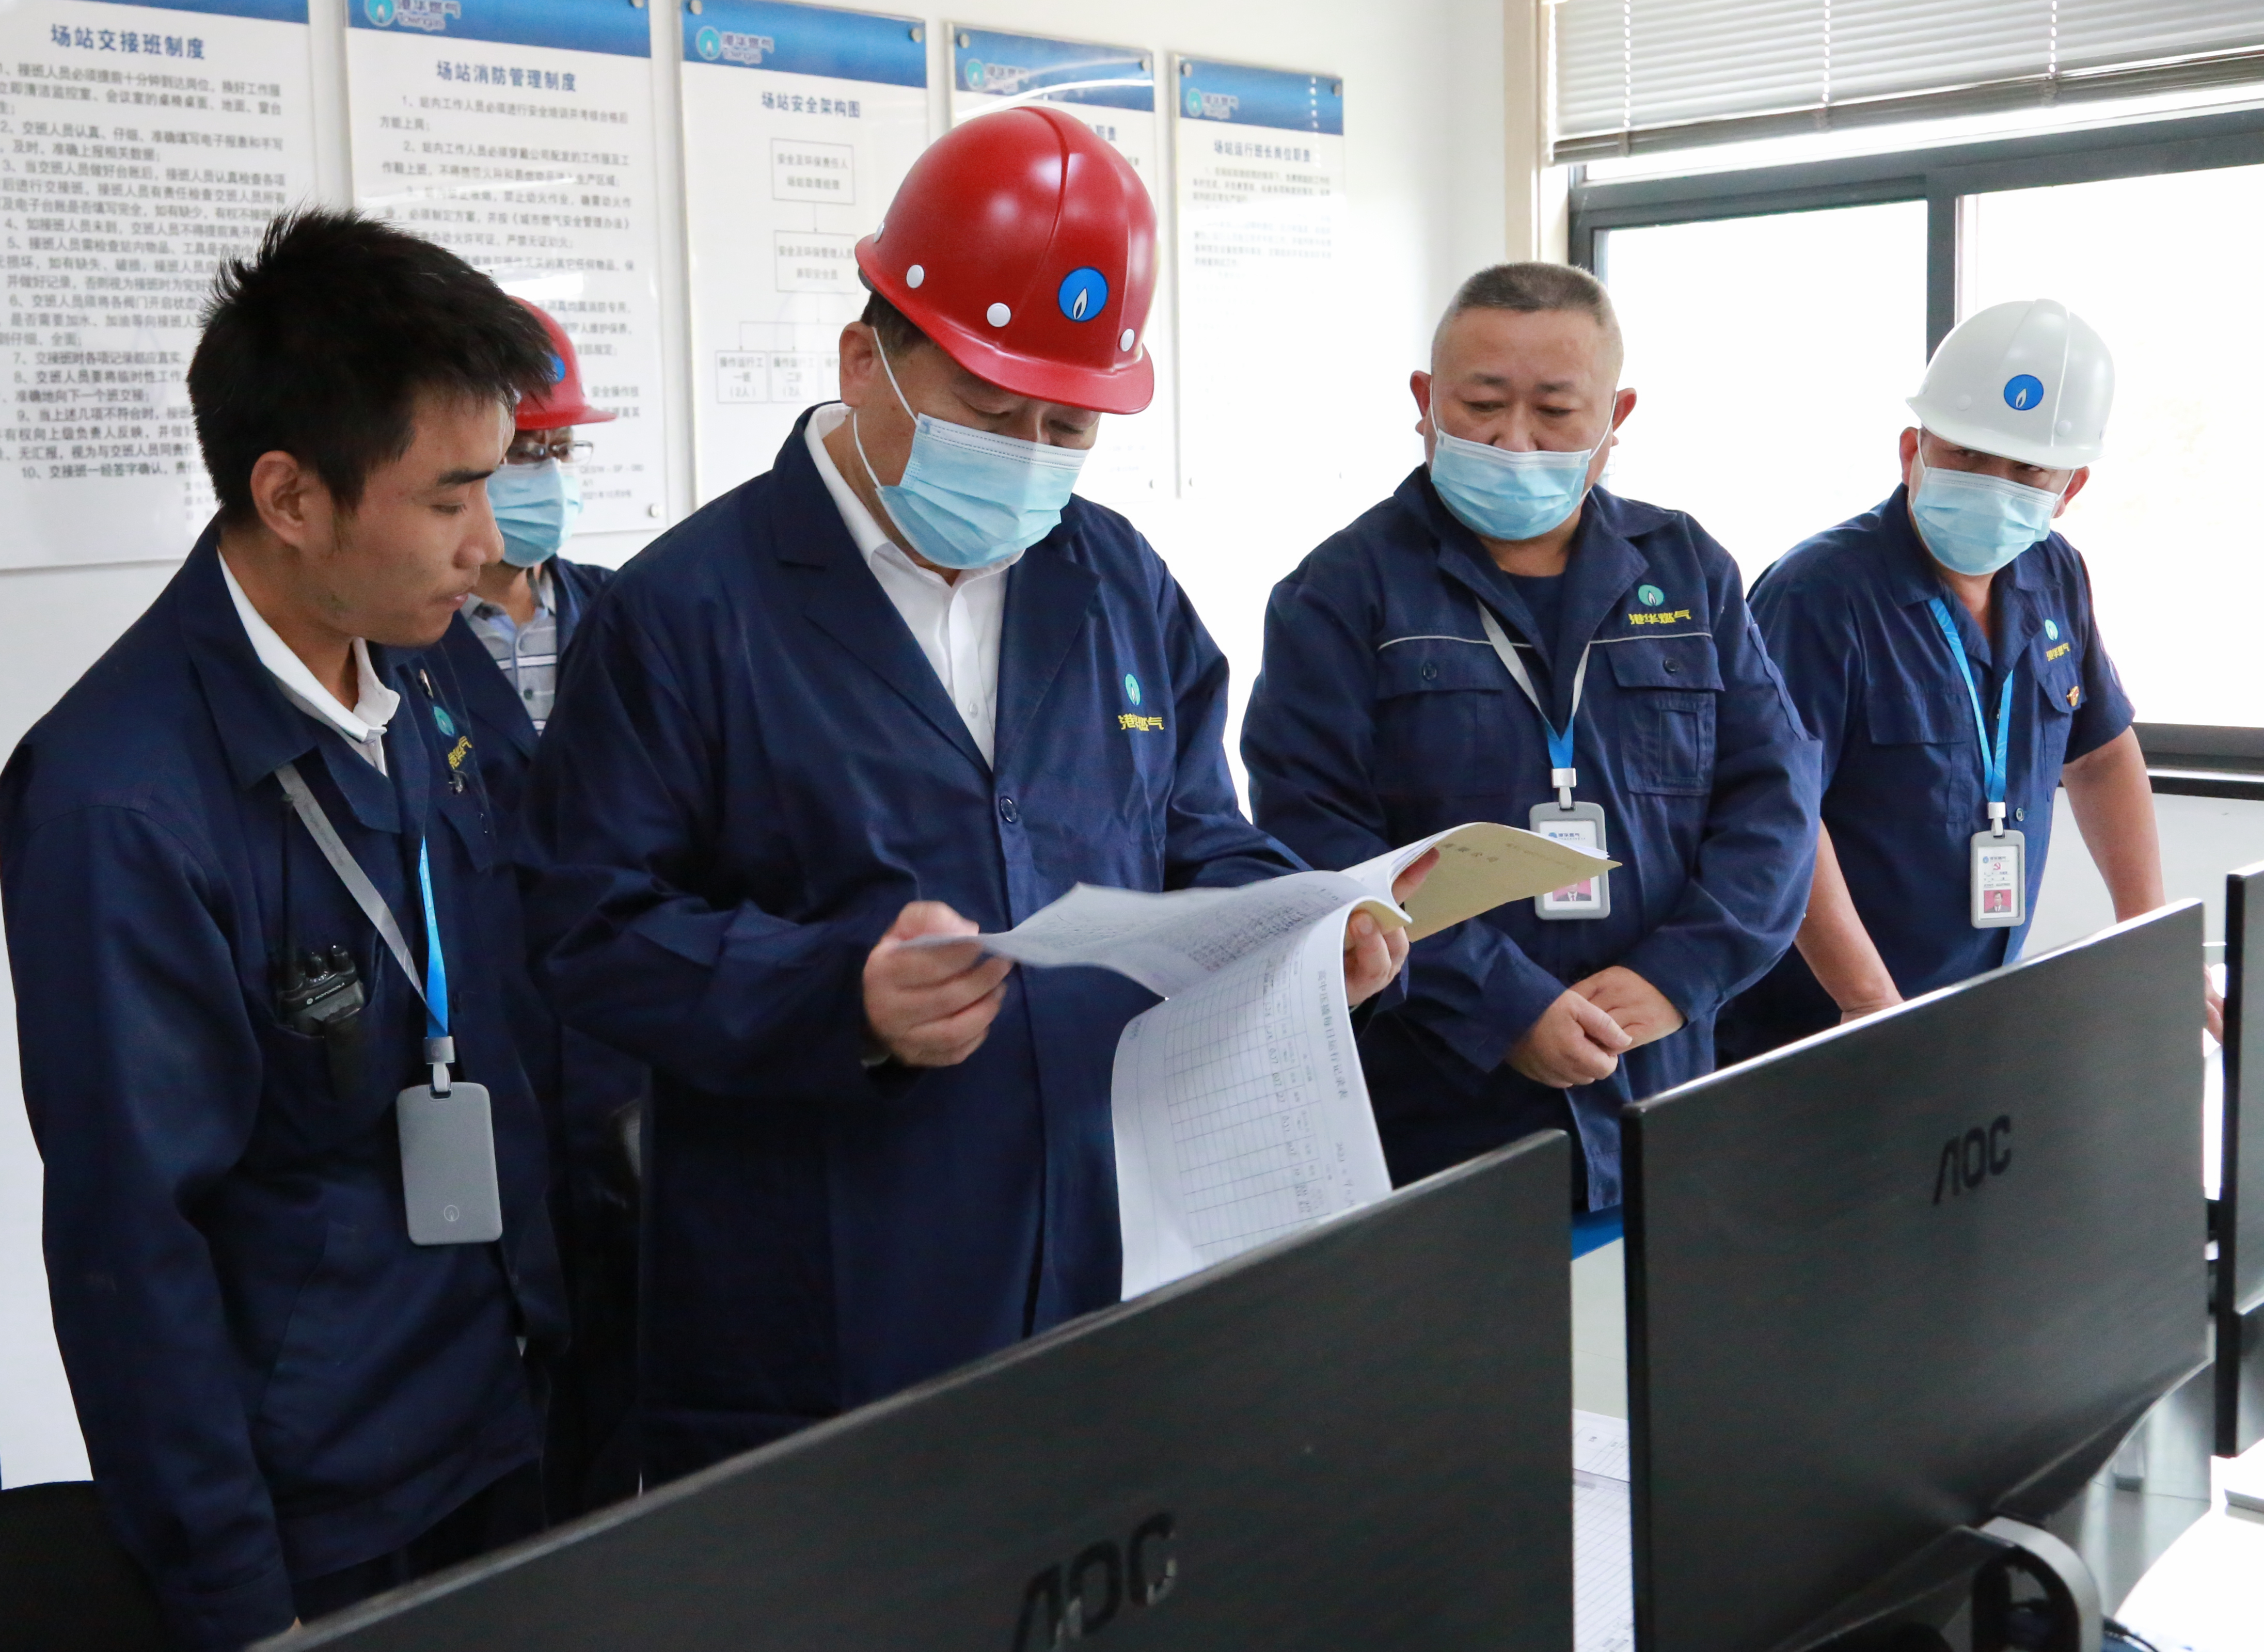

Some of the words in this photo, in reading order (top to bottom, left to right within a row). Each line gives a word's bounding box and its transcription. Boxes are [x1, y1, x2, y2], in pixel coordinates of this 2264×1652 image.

[51, 24, 205, 59] 场站交接班制度
[436, 60, 576, 92] 场站消防管理制度
[762, 91, 861, 119] 场站安全架构图
[1628, 609, 1691, 625] 港华燃气
[315, 982, 345, 1000] MOTOROLA
[1933, 1115, 2012, 1205] AOC
[1011, 1512, 1178, 1652] AOC
